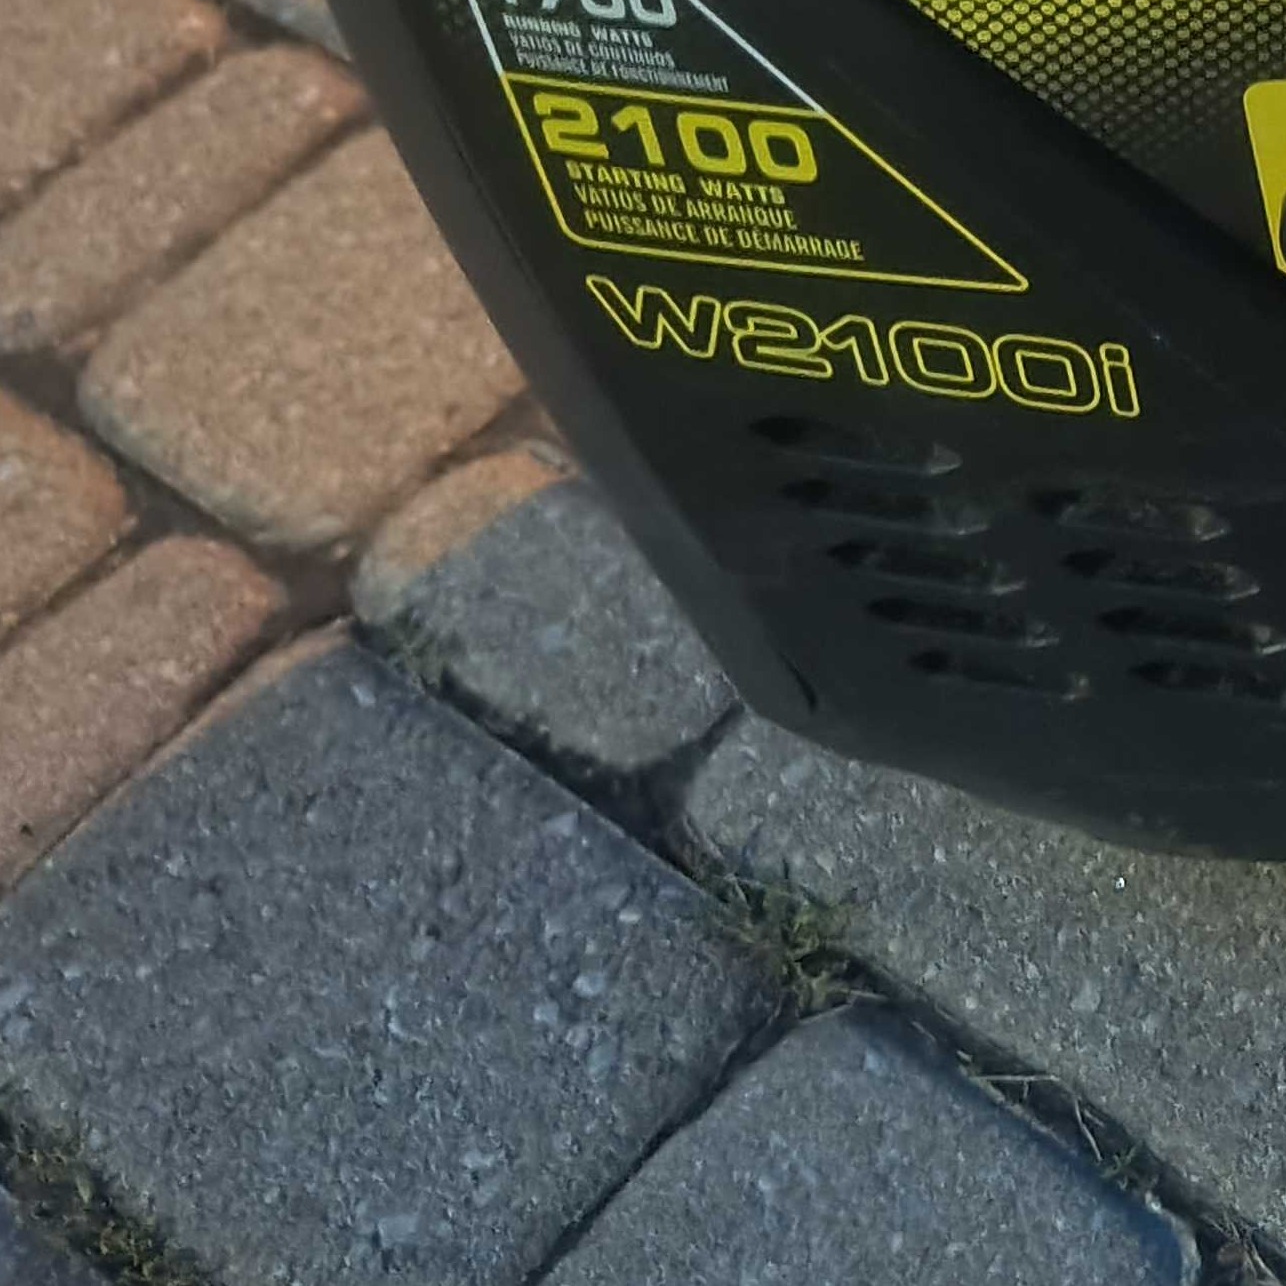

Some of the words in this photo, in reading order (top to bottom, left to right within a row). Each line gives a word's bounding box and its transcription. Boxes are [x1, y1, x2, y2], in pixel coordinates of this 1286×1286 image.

[502, 14, 582, 39] RUNNING
[591, 25, 653, 48] WATTS
[509, 31, 562, 54] VATIOS
[564, 40, 584, 57] DE
[587, 42, 676, 69] CONTINUOS
[532, 91, 819, 184] 2100
[565, 160, 687, 194] STARTING
[699, 176, 787, 205] WATTS
[573, 183, 648, 213] VATIOS
[650, 196, 681, 218] DE
[685, 198, 798, 230] ARRANQUE
[583, 208, 701, 245] PUISSANCE
[703, 226, 736, 249] DE
[585, 274, 1142, 418] W2100i
